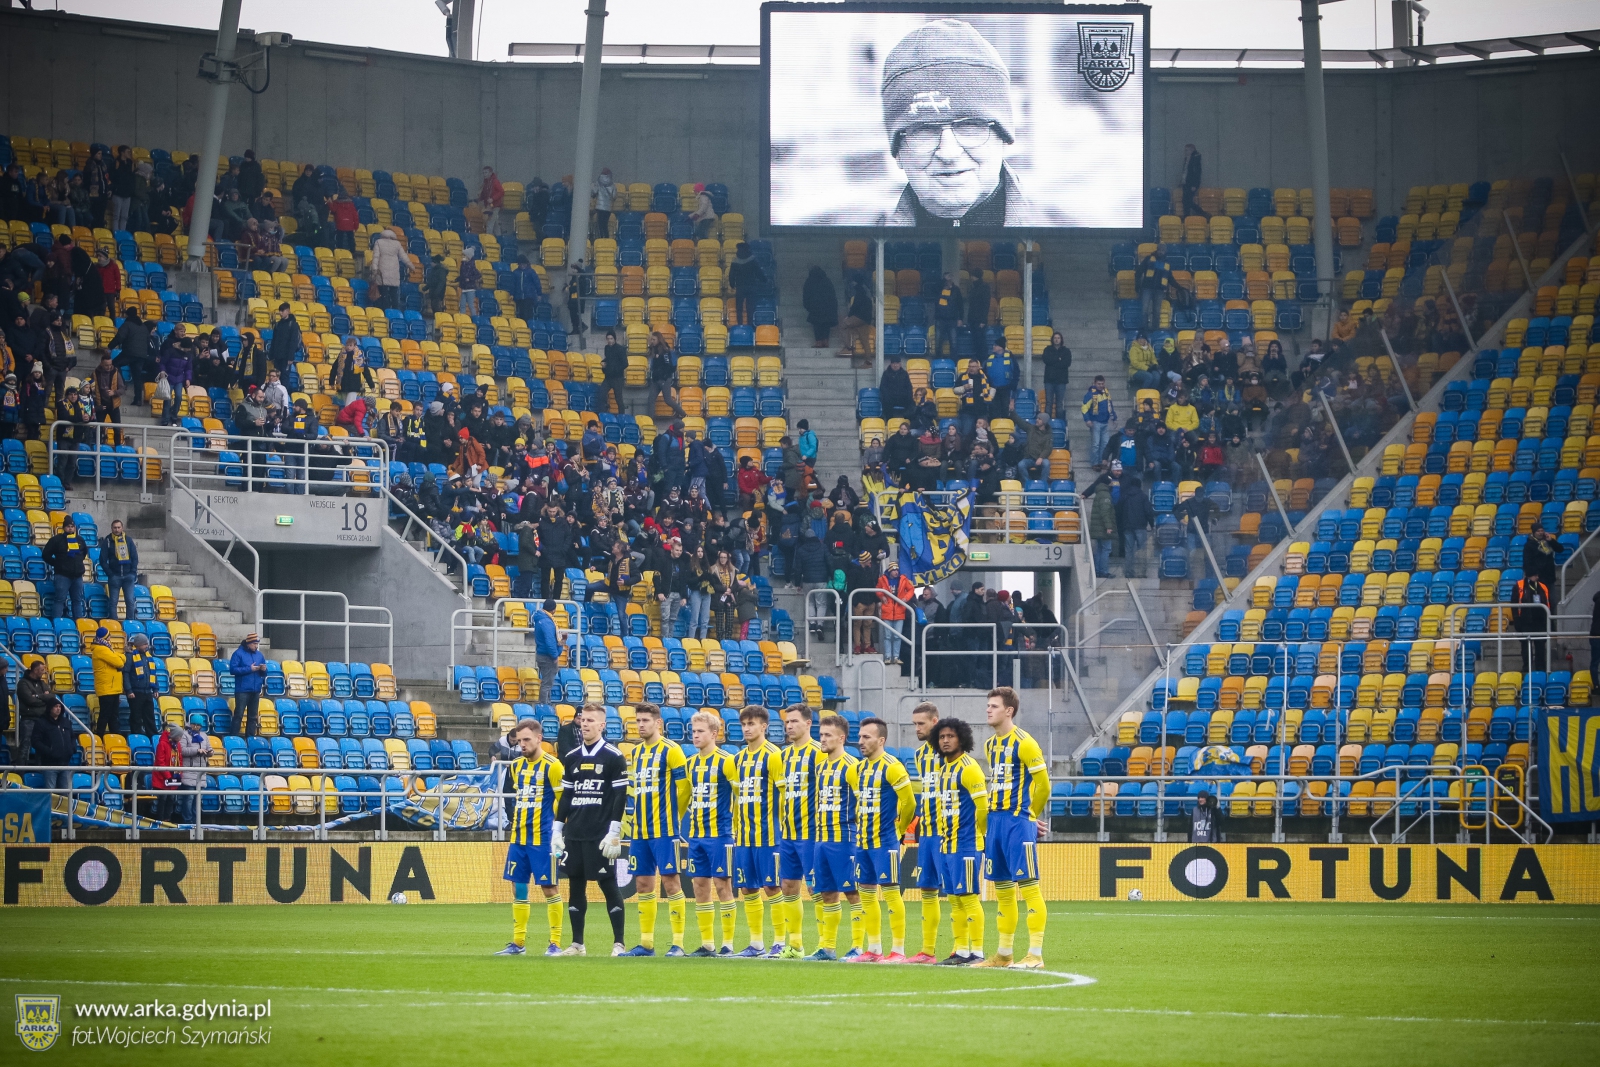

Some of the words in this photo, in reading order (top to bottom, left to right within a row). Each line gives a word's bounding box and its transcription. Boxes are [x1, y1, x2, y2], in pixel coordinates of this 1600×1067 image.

[1088, 60, 1124, 68] ARKA
[213, 495, 239, 505] SEKTOR
[309, 498, 336, 509] WEJŚCIE
[341, 501, 368, 532] 18
[211, 528, 225, 536] 40-21
[336, 533, 358, 542] MIEJSCA
[358, 534, 372, 542] 20-01
[1044, 546, 1062, 561] 19
[0, 813, 36, 843] SA
[4, 846, 436, 905] FORTUNA
[1099, 846, 1555, 901] FORTUNA
